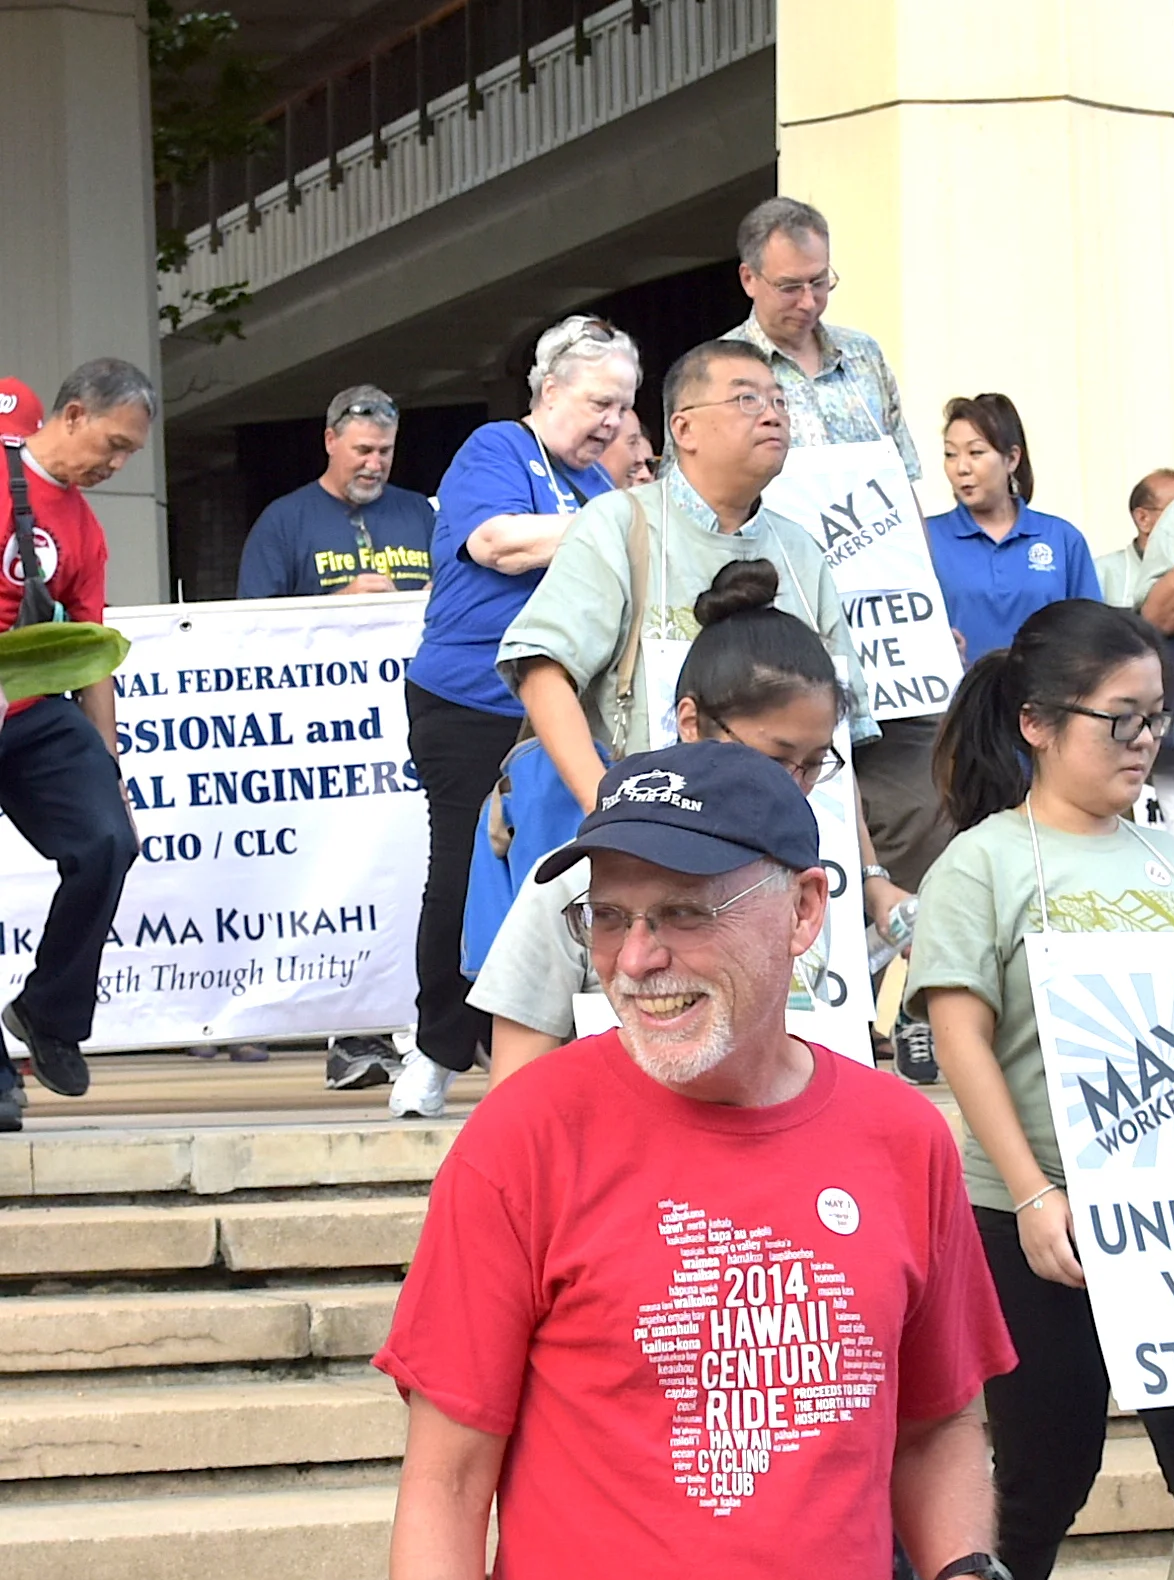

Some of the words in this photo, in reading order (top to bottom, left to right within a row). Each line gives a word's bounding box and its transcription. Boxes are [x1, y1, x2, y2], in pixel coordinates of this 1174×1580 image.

[820, 492, 863, 553] AY
[867, 479, 894, 510] 1
[872, 509, 903, 537] DAY
[315, 550, 355, 574] Fire
[858, 637, 906, 669] WE
[177, 660, 369, 694] FEDERATION
[306, 706, 384, 744] and
[187, 759, 422, 807] ENGINEERS
[659, 791, 703, 812] BERN
[235, 827, 298, 858] CLC
[151, 959, 264, 997] Through
[723, 1261, 809, 1309] 2014
[709, 1300, 829, 1350] HAWAII
[701, 1342, 842, 1390] CENTURY
[793, 1384, 842, 1400] PROCEEDS
[794, 1399, 814, 1413] THE
[706, 1387, 789, 1431] RIDE
[709, 1429, 772, 1451] HAWAII
[697, 1449, 770, 1474] CYCLING
[711, 1472, 755, 1497] CLUB
